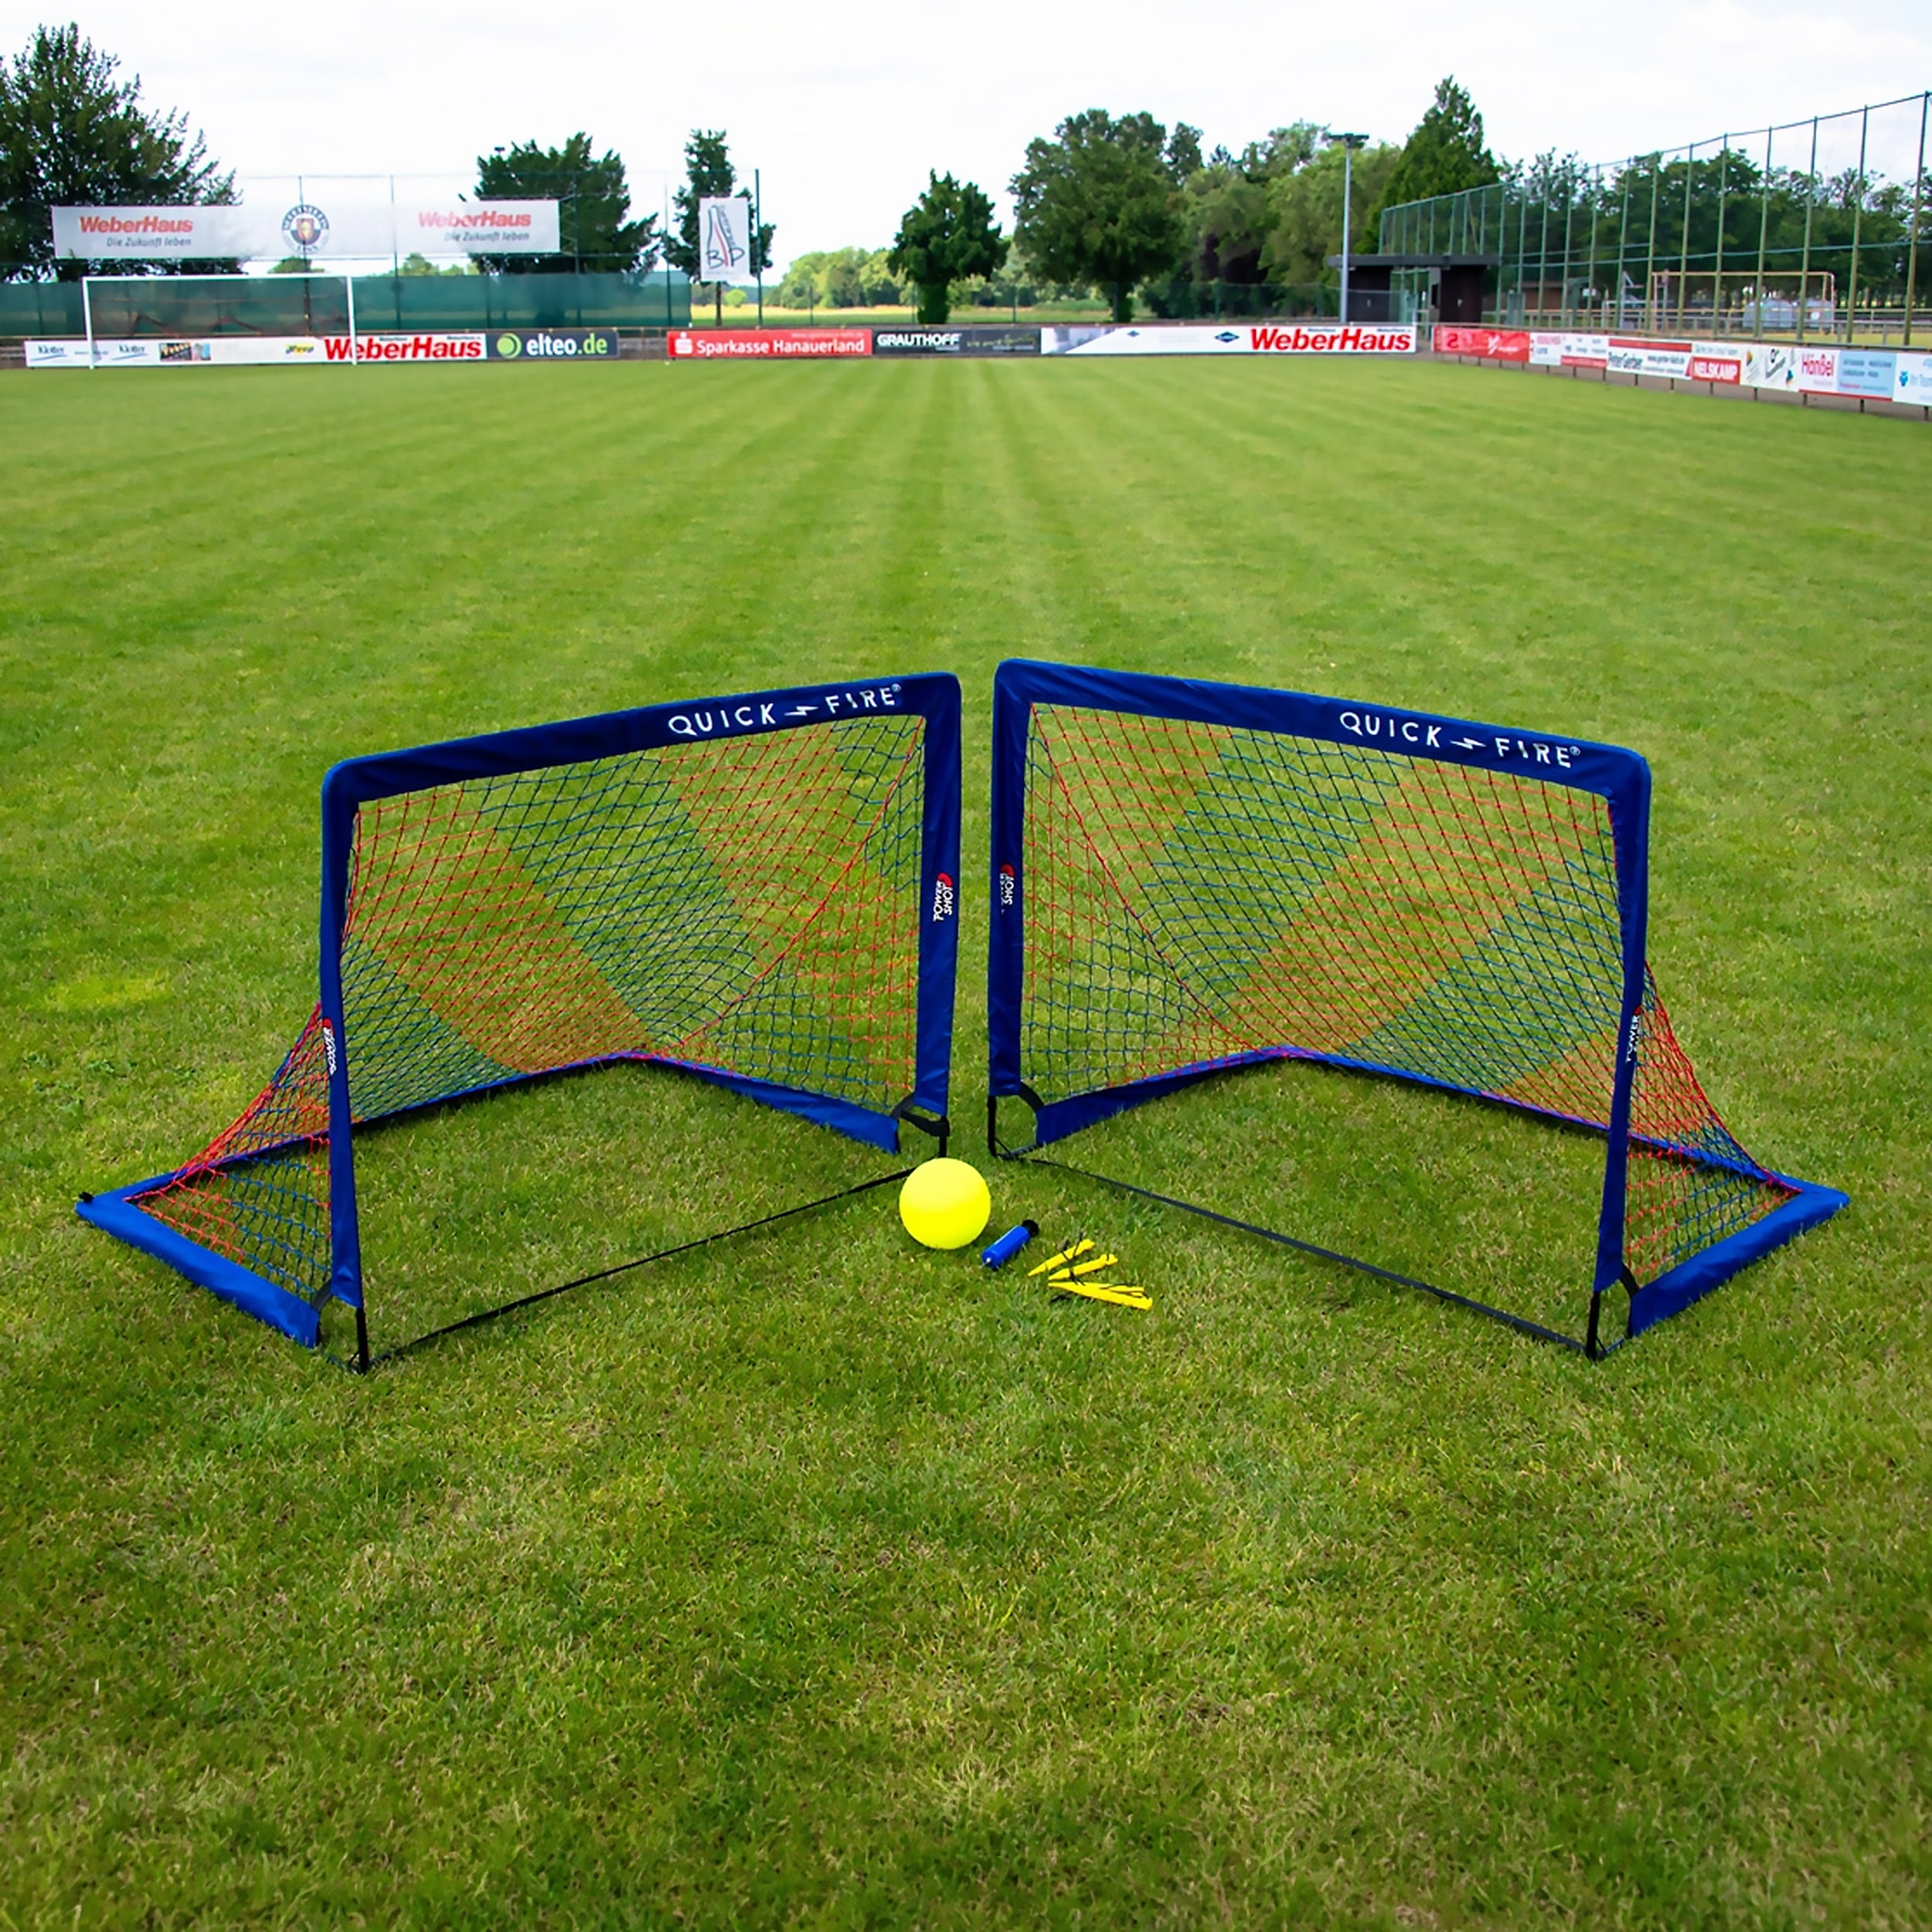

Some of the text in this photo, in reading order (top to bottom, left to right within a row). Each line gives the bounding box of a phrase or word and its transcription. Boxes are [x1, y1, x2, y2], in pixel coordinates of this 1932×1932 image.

[80, 216, 193, 233] WeberHaus
[418, 209, 532, 230] WeberHaus
[106, 236, 192, 248] Die Zukunft leben
[444, 230, 530, 243] Die Zukunft leben
[324, 337, 482, 362] WeberHaus
[526, 333, 609, 357] elteo.de
[696, 339, 865, 357] Sparkasse Hanauerland
[877, 333, 962, 347] GRAUTHOFF
[1250, 328, 1410, 351] WeberHaus
[1694, 361, 1738, 380] NELSKAMP
[668, 702, 777, 737] QUICK
[1339, 710, 1444, 748] QUICK
[932, 879, 945, 922] POWER
[942, 886, 954, 916] SHOT
[1004, 875, 1015, 906] SHOT
